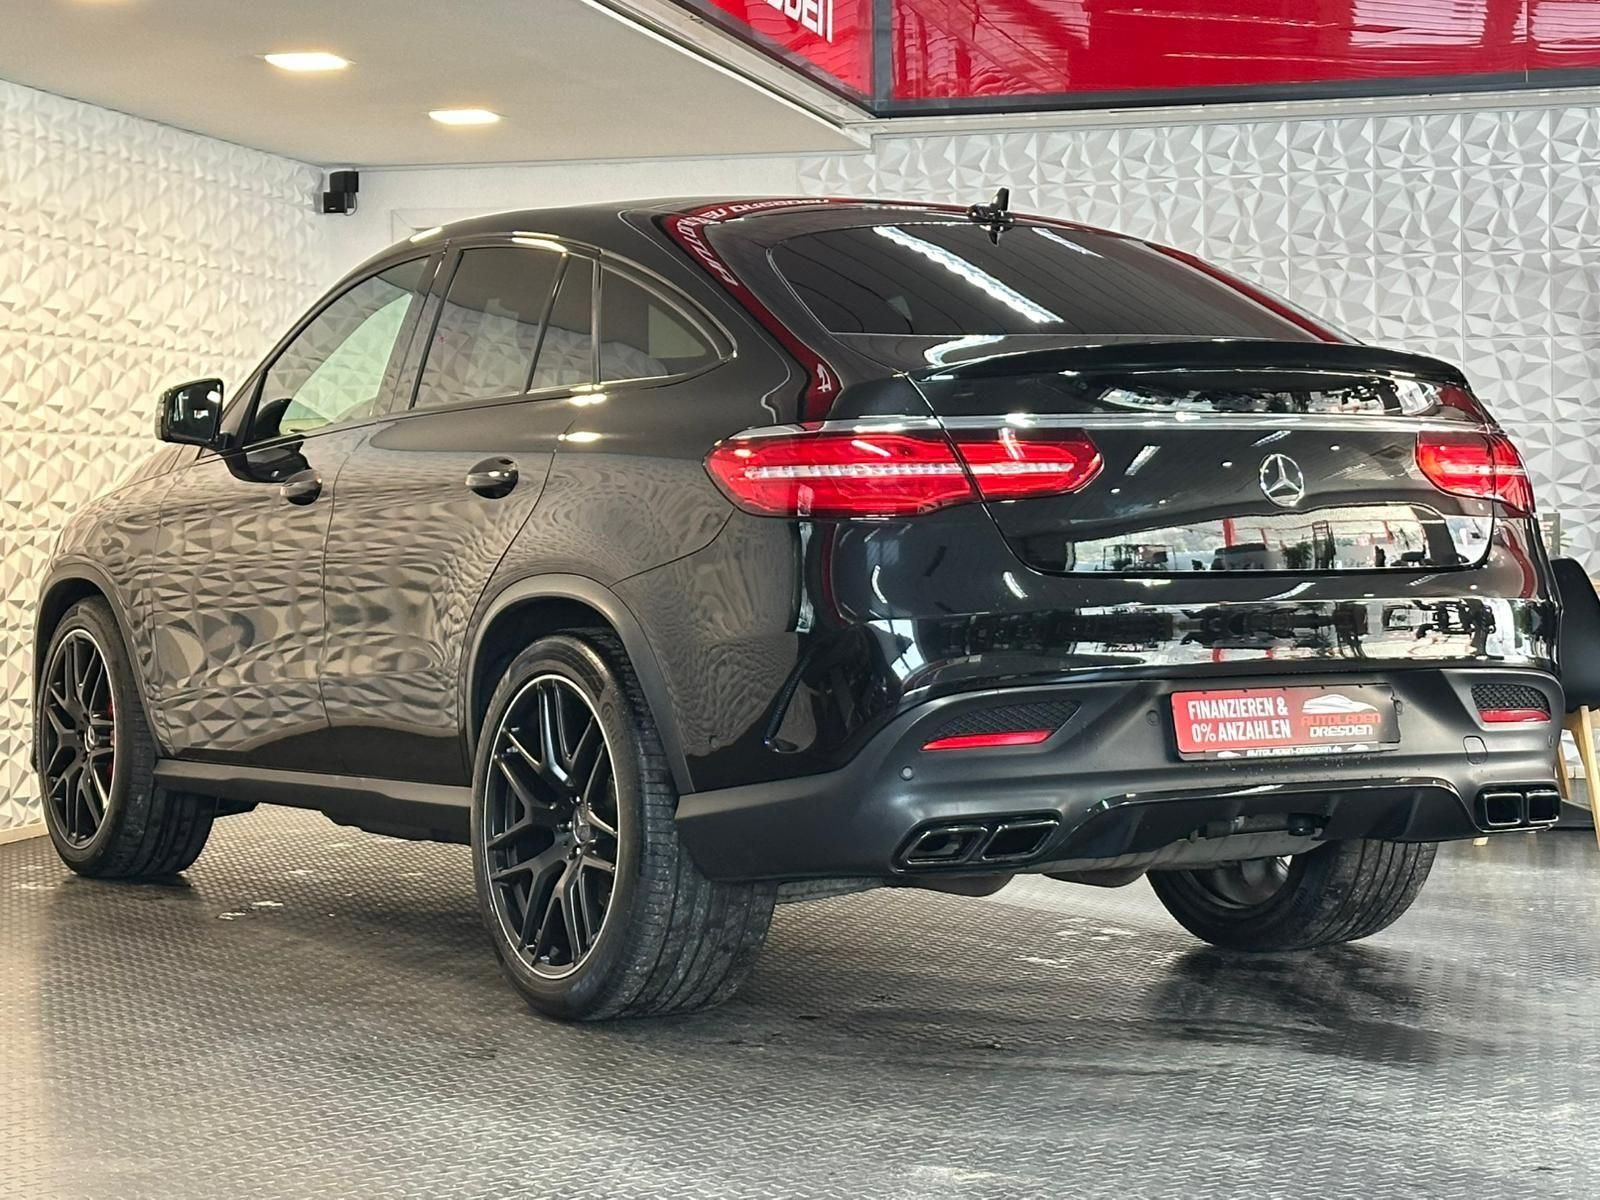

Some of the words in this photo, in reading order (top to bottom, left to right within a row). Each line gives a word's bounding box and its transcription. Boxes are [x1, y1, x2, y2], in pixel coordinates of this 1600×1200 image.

[1187, 697, 1275, 720] FINANZIEREN
[1276, 696, 1289, 716] &
[1300, 712, 1381, 726] AUTOLADEN
[1191, 723, 1217, 743] 0%
[1218, 719, 1292, 742] ANZAHLEN
[1309, 724, 1373, 738] DRESDEN
